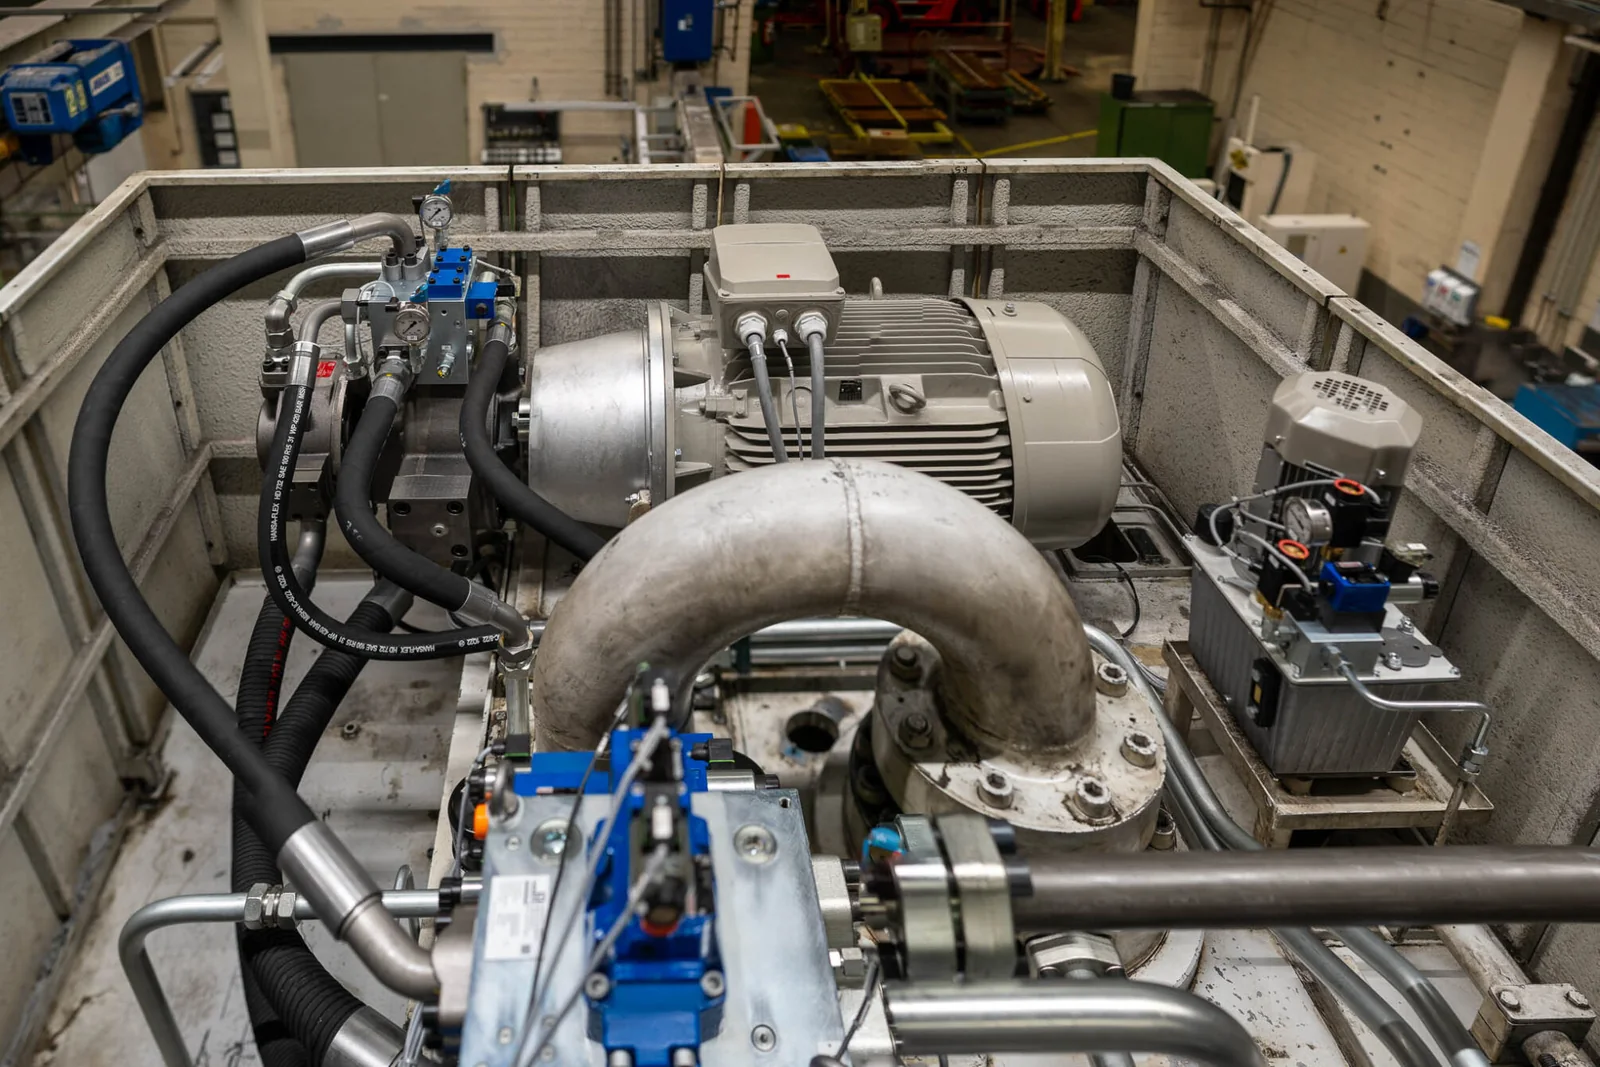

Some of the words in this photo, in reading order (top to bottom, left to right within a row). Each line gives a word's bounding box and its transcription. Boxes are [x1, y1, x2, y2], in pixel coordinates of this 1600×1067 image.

[295, 400, 303, 413] BAR
[290, 424, 297, 435] WP
[284, 444, 292, 455] R15
[279, 466, 287, 478] SAE
[276, 480, 284, 490] 732
[274, 490, 282, 500] HD
[270, 502, 280, 541] HANSA-FLEX
[295, 605, 311, 622] MSHA
[308, 618, 321, 631] BAR
[319, 626, 329, 636] 420
[327, 631, 338, 641] WP
[338, 636, 345, 644] 31
[346, 639, 356, 648] R15
[356, 642, 365, 650] 100
[401, 645, 435, 653] HANSA-FLEX
